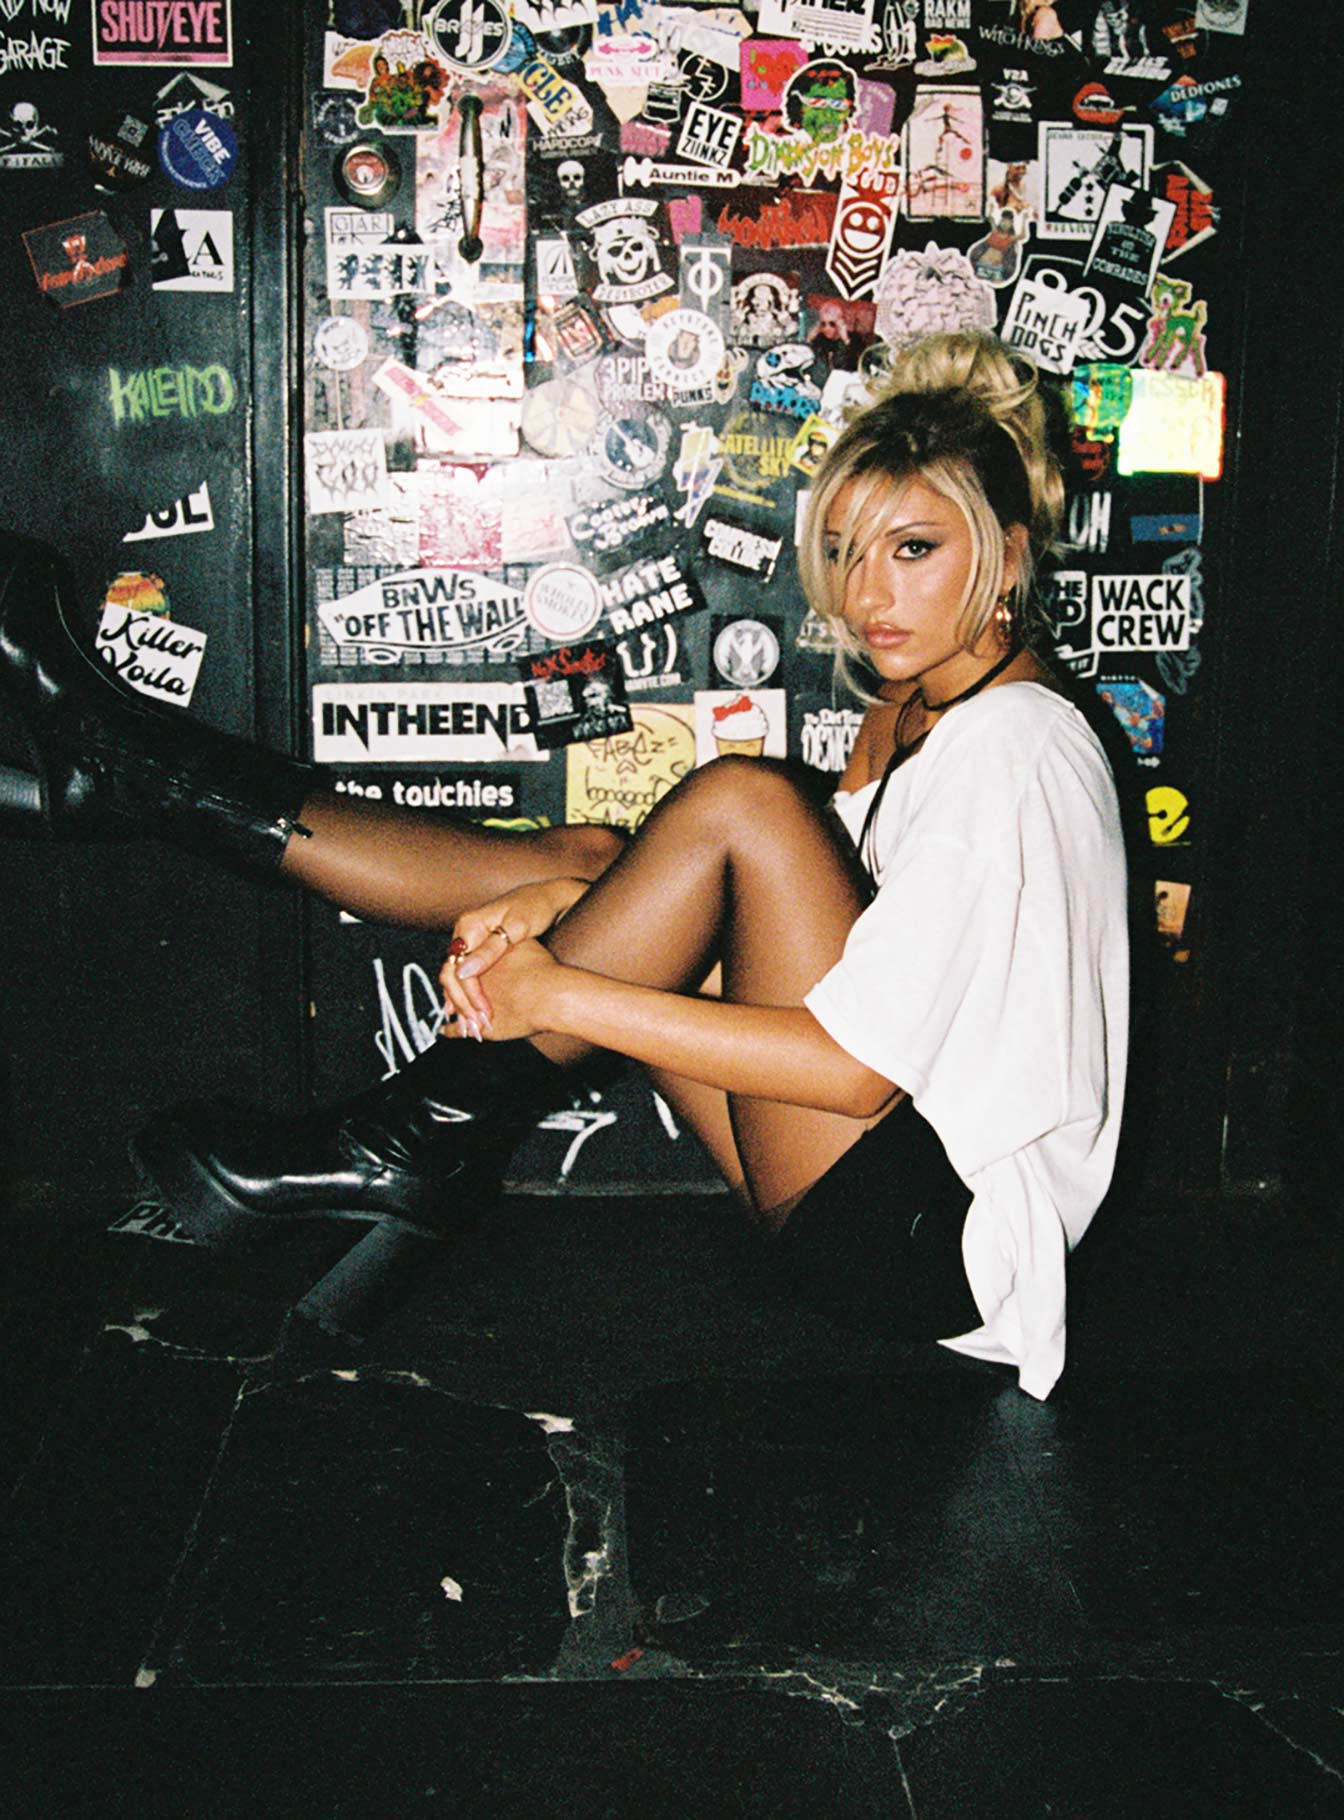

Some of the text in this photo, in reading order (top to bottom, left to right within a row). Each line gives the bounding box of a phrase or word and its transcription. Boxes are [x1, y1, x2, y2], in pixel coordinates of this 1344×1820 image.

[194, 118, 231, 165] VIBE
[688, 106, 738, 150] EYE
[649, 168, 734, 183] Auntie M
[1014, 291, 1078, 342] PINCH
[1011, 325, 1067, 363] DOGS
[600, 555, 682, 607] HATE
[1098, 578, 1186, 612] WACK
[100, 612, 204, 660] Killer
[396, 604, 454, 641] THE
[1096, 613, 1187, 648] CREW
[393, 777, 514, 808] touchies
